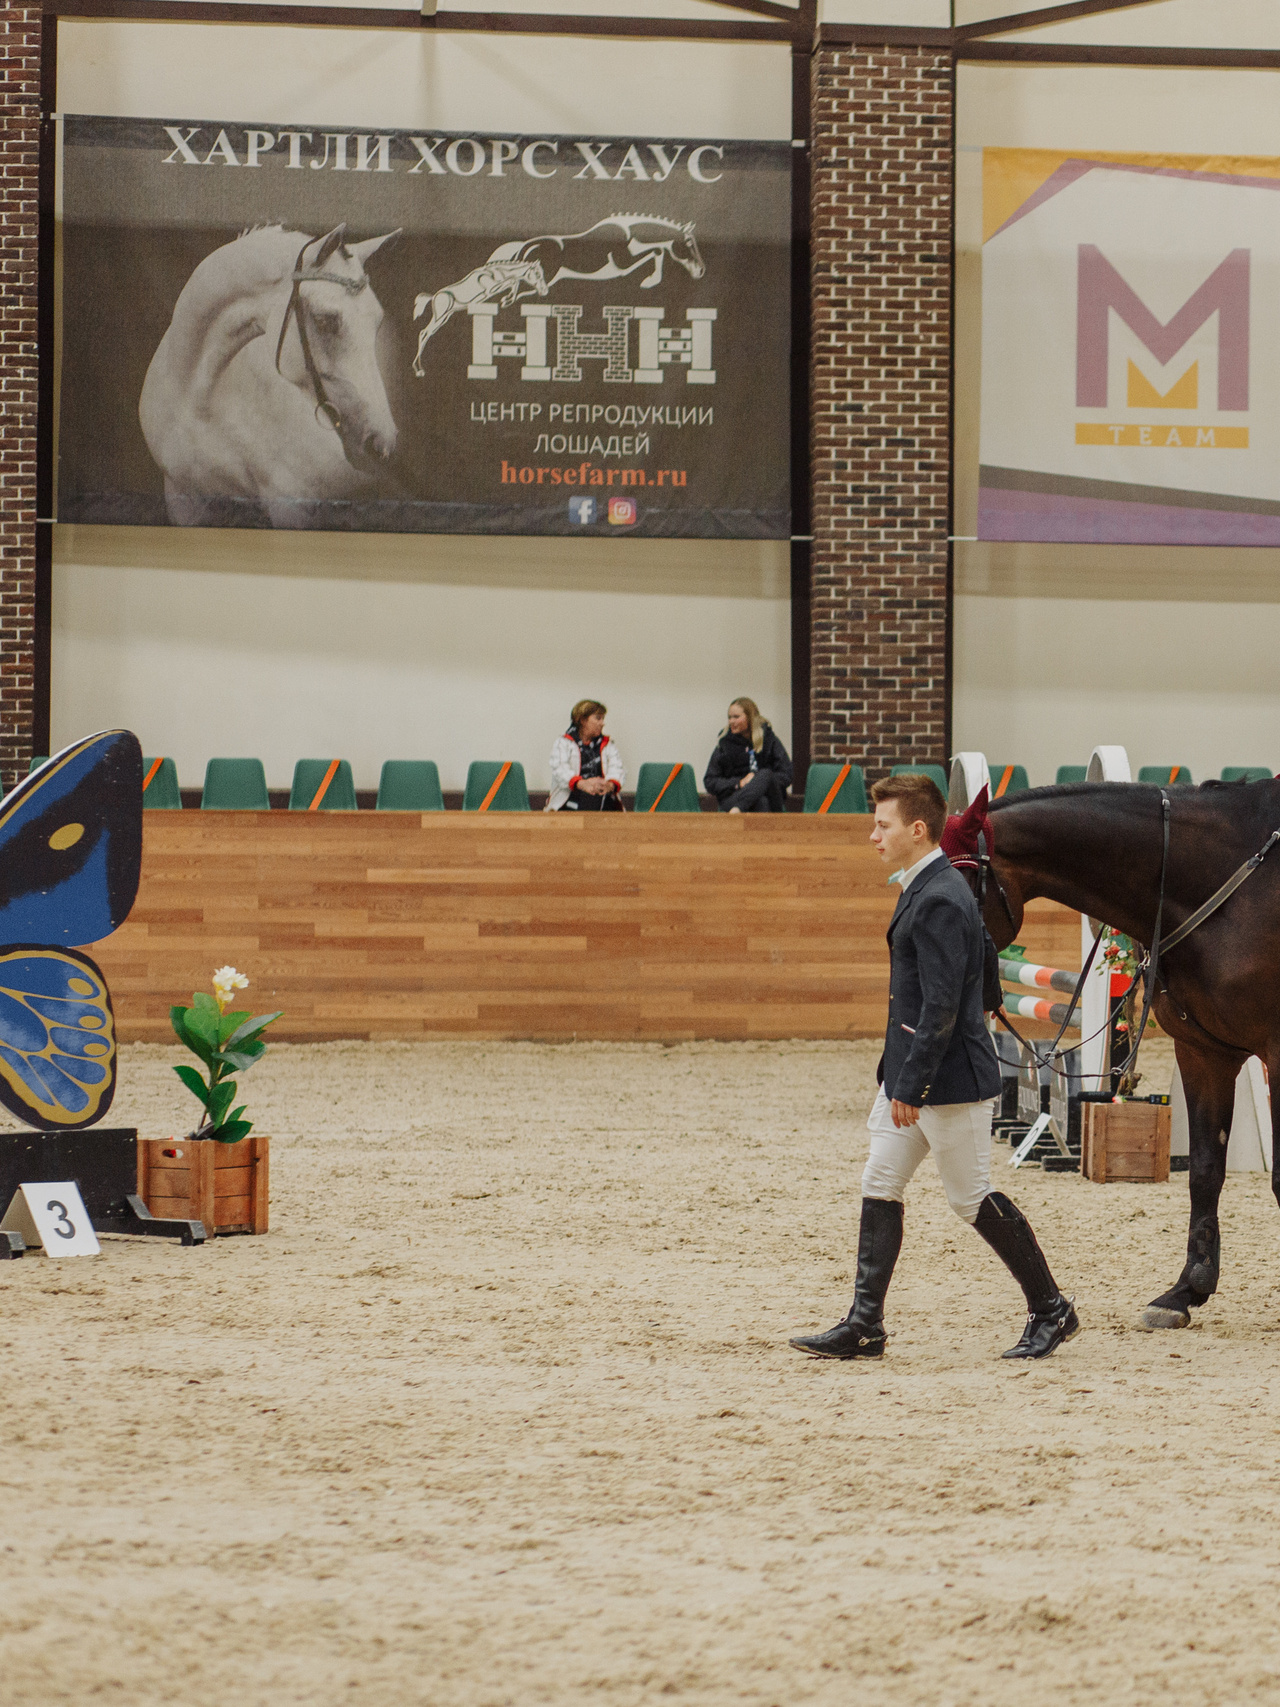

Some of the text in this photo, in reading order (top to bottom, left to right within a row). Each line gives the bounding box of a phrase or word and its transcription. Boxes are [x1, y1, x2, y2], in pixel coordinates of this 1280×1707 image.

[161, 126, 724, 183] ХАРТЛИ ХОРС ХАУС
[470, 402, 714, 428] ЦЕНТР РЕПРОДУКЦИИ
[533, 432, 650, 458] ЛОШАДЕЙ
[501, 460, 687, 487] horsefarm.ru
[46, 1199, 76, 1239] 3
